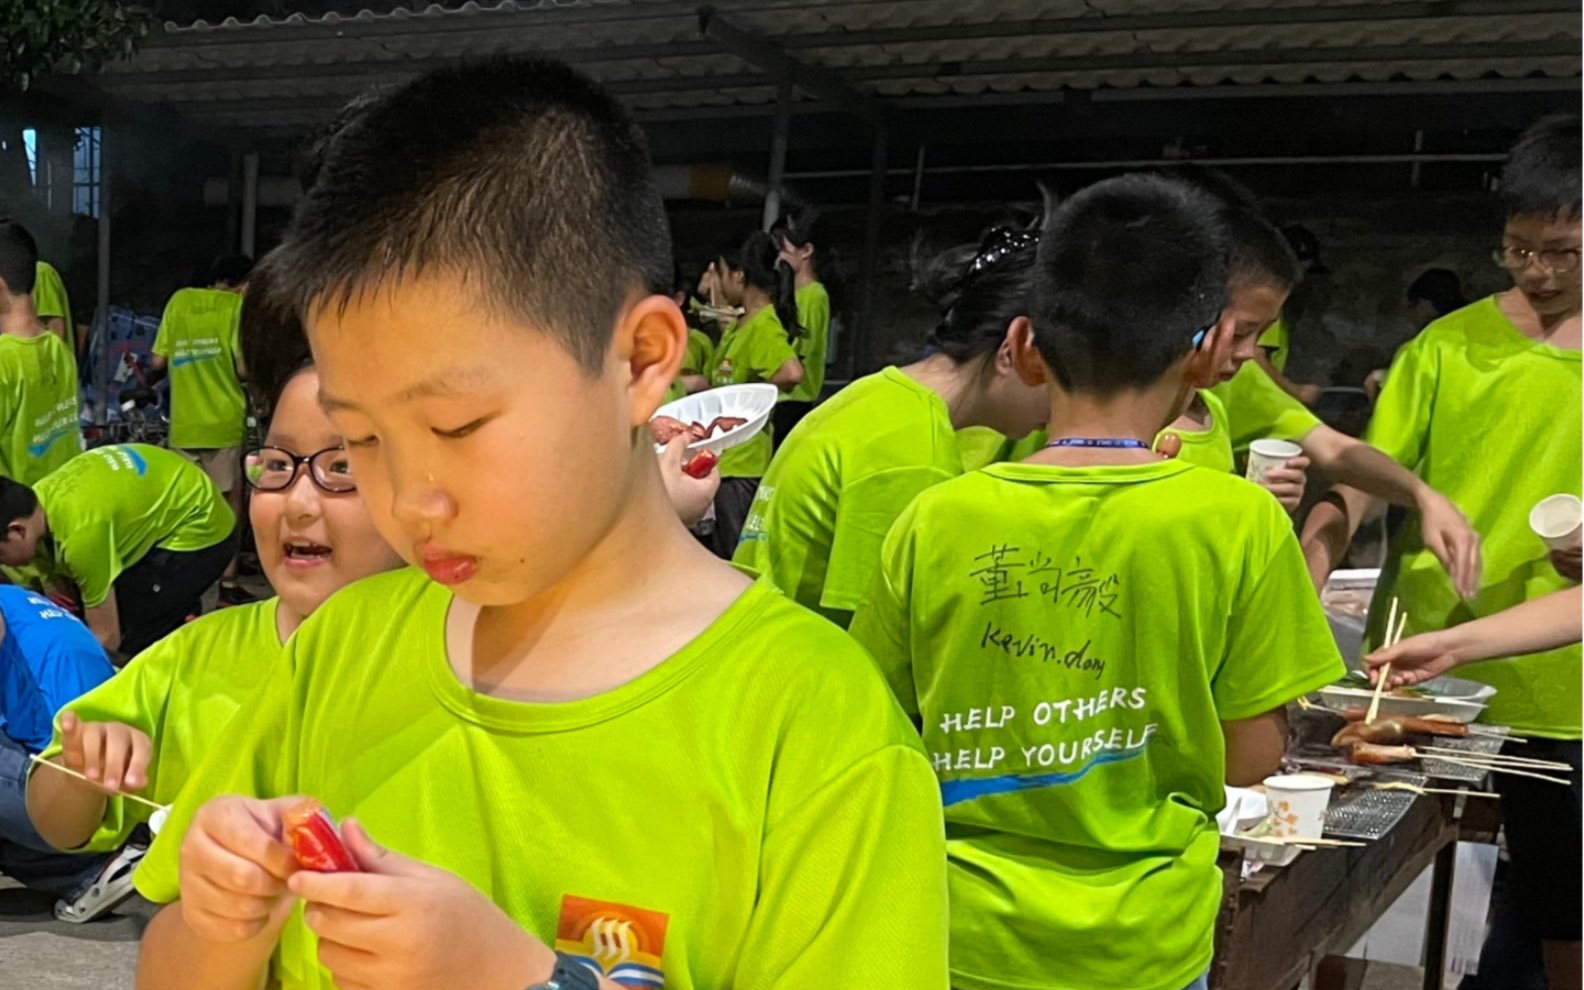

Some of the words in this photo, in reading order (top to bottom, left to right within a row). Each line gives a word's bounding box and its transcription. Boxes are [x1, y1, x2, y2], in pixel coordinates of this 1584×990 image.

[940, 705, 1016, 733] HELP
[1033, 687, 1147, 726] OTHERS
[933, 746, 1005, 771] HELP
[1021, 723, 1159, 767] YOURSELF
